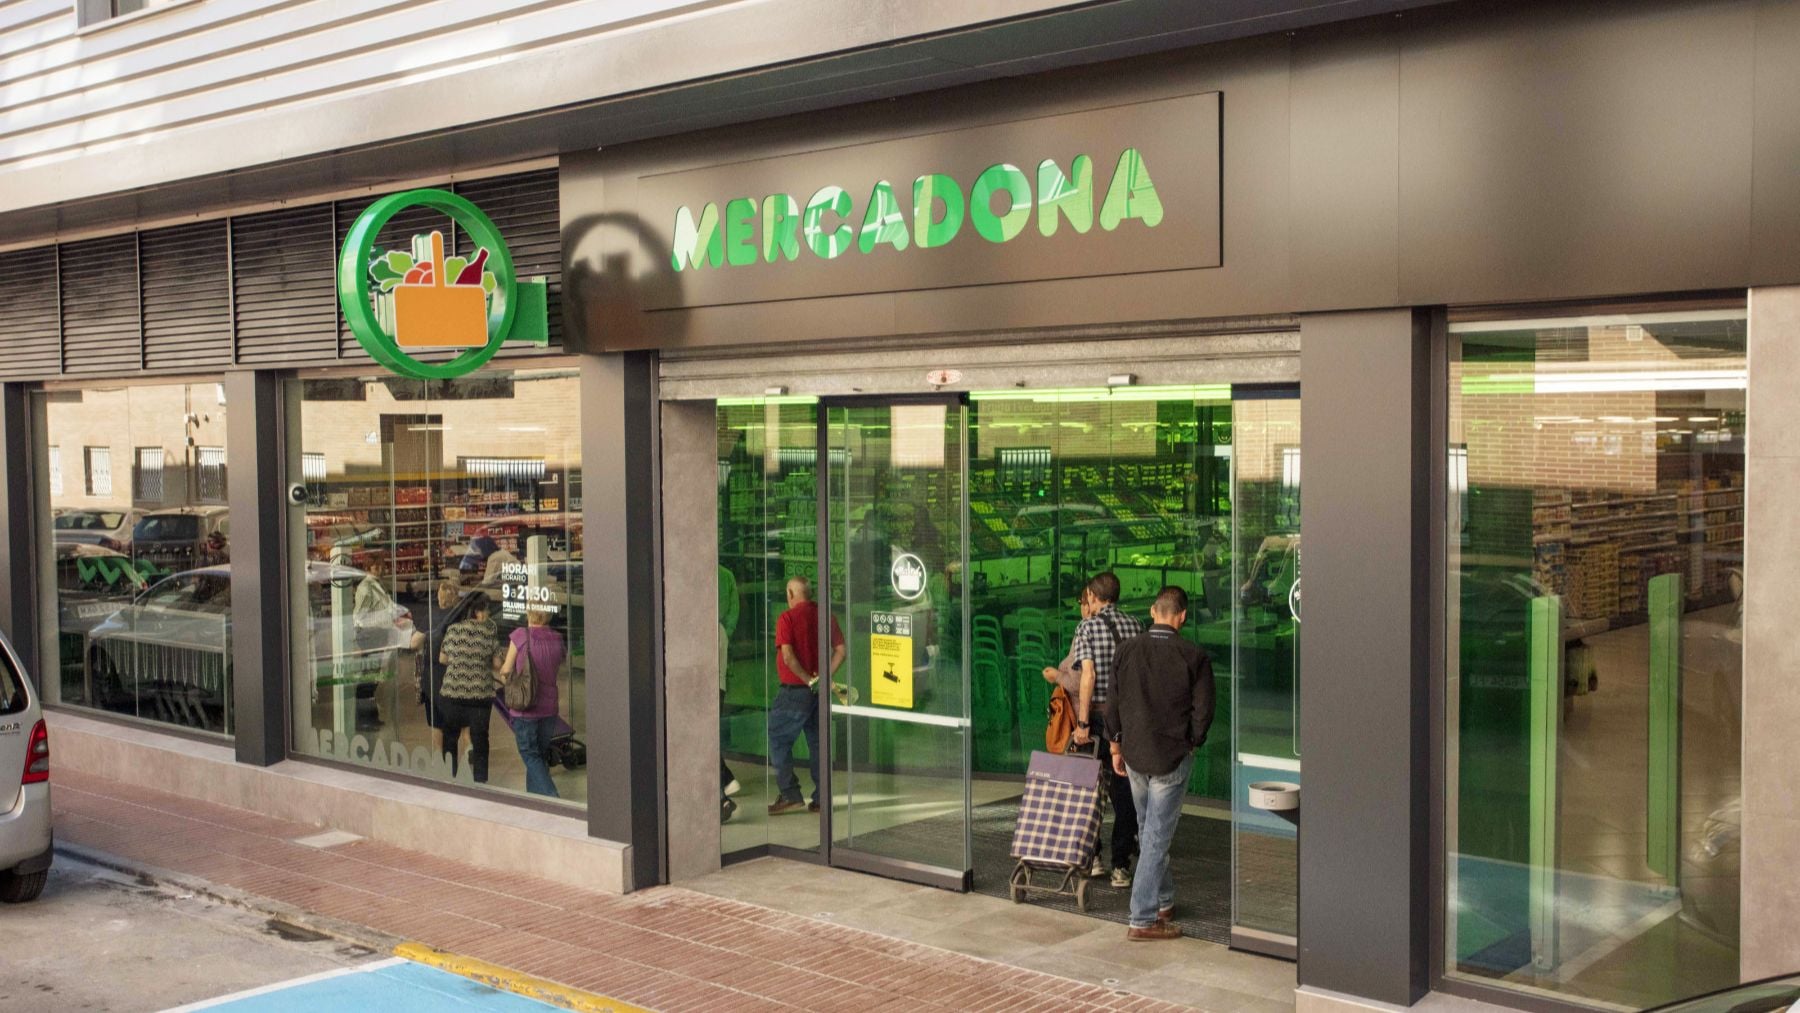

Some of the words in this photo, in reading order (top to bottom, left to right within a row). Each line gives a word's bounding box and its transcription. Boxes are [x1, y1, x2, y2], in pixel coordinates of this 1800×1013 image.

[670, 147, 1165, 272] MERCADONA
[502, 562, 538, 576] HORARI
[502, 583, 510, 599] 9
